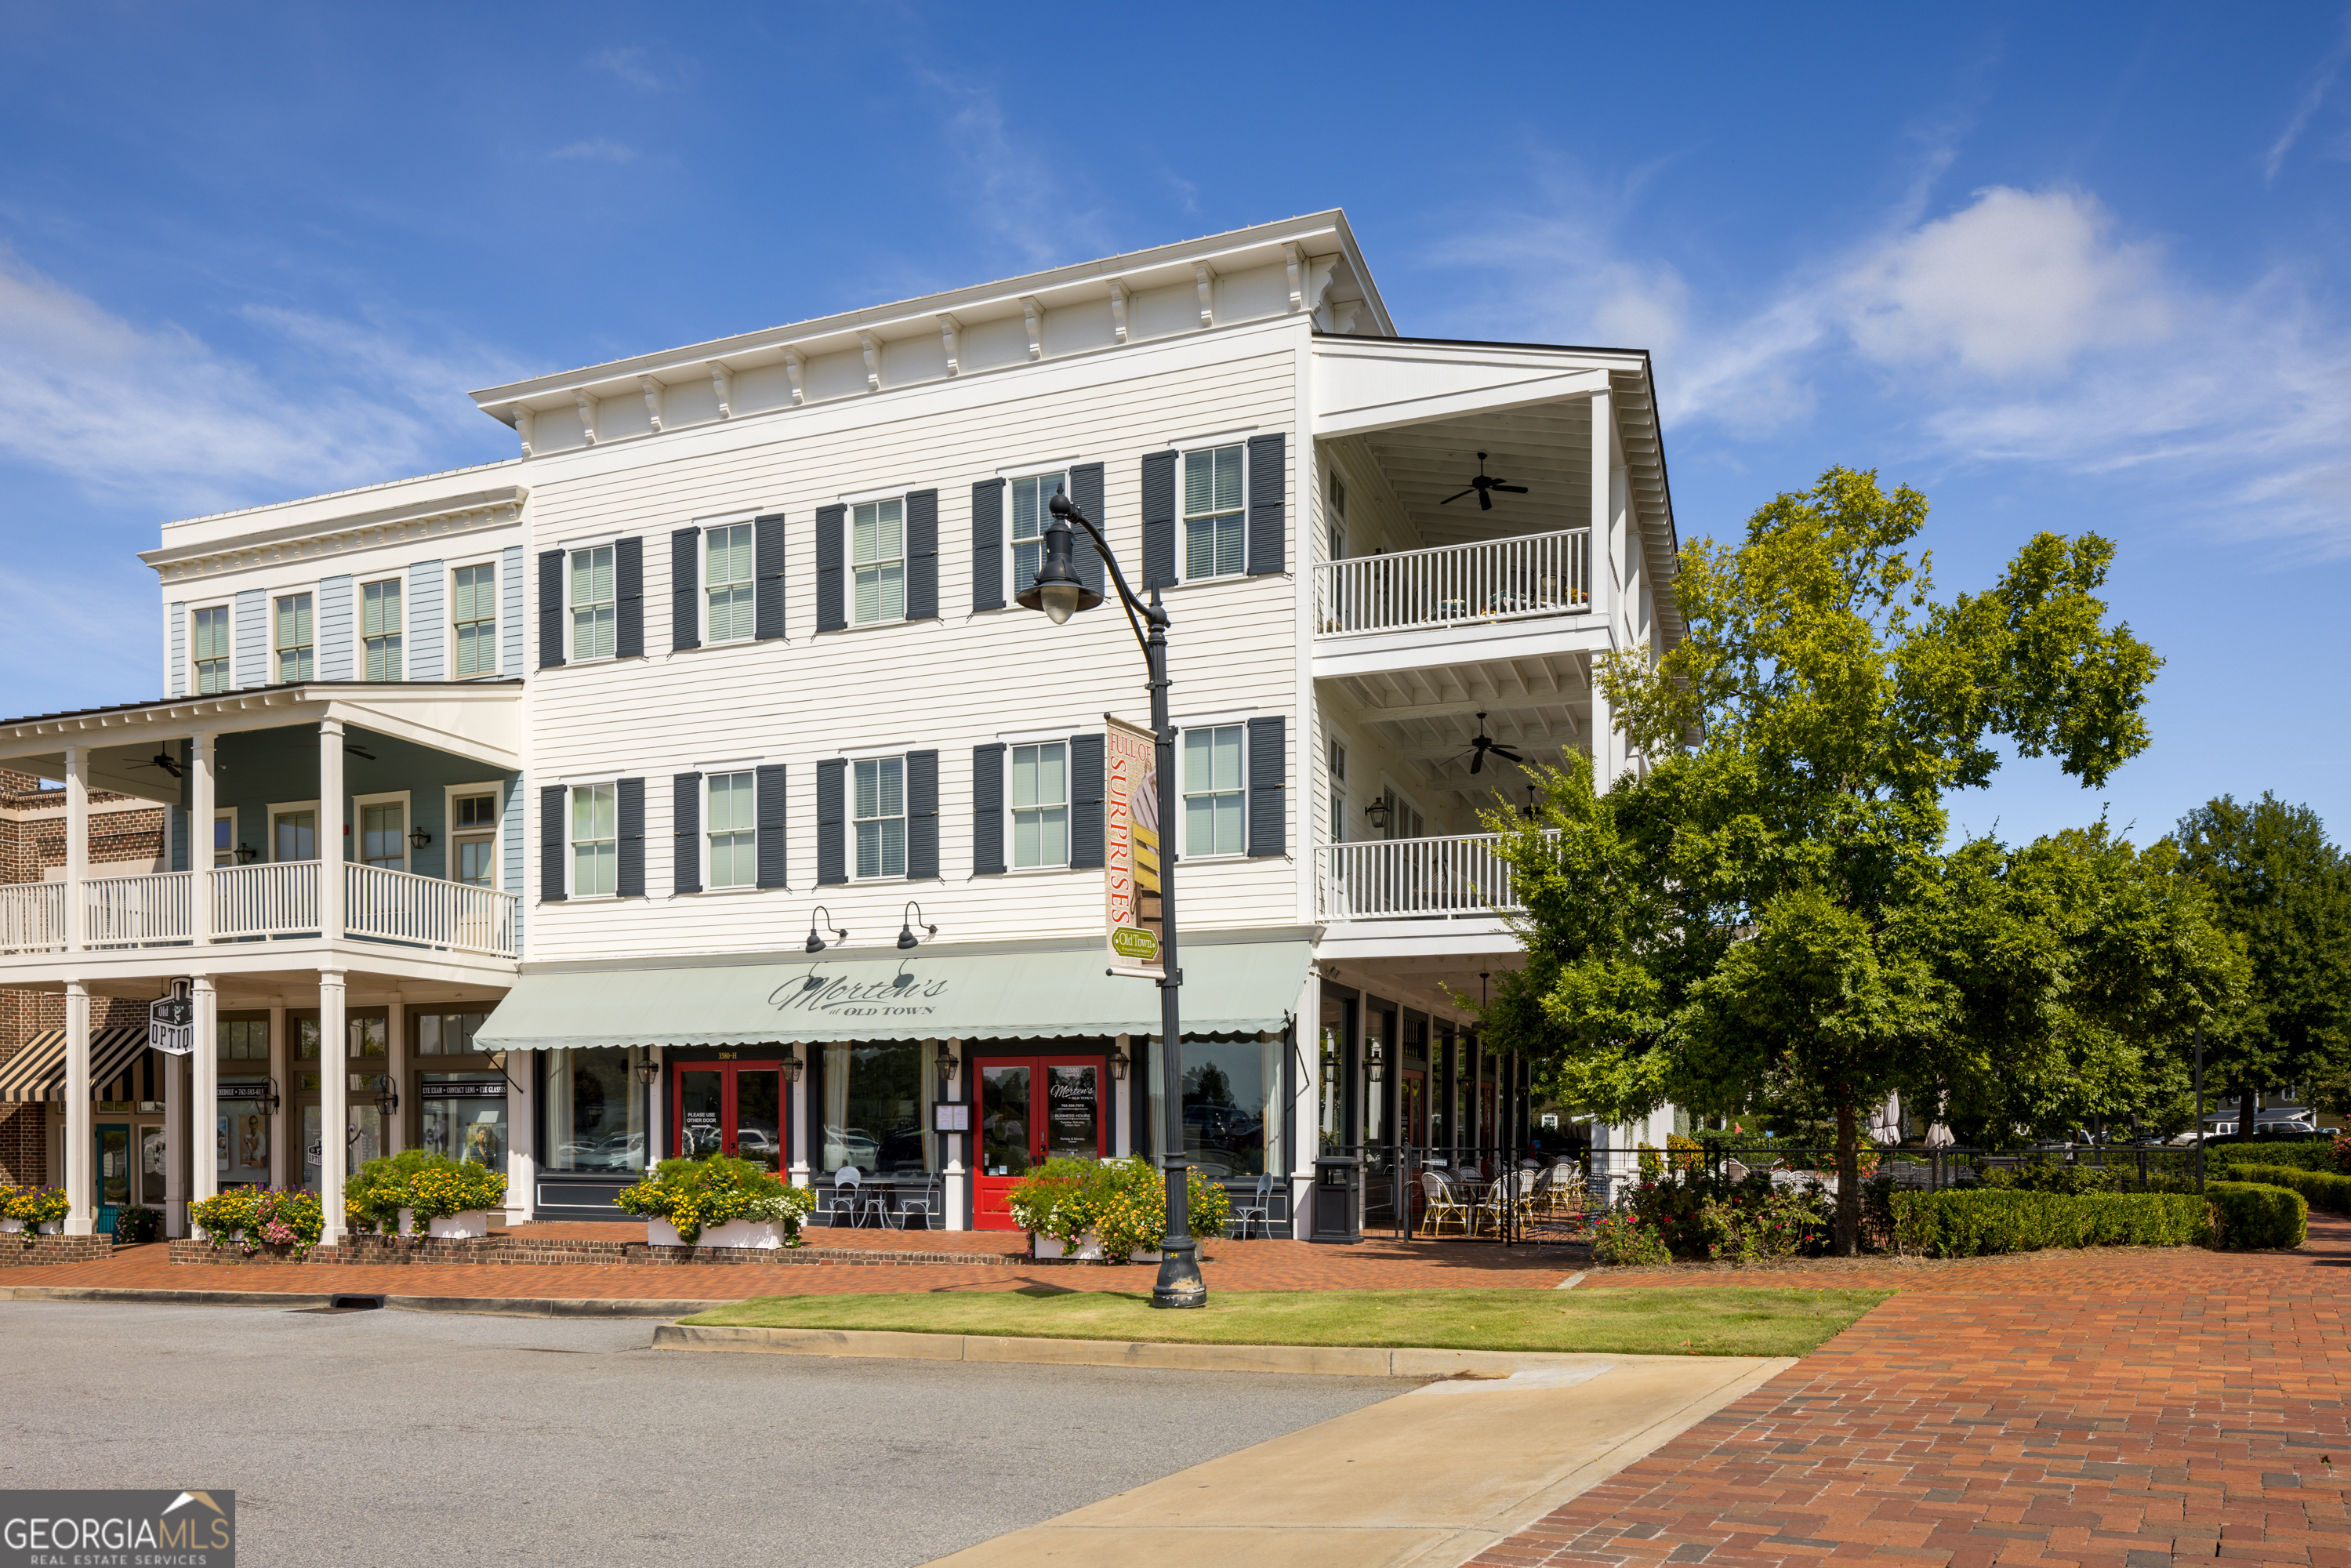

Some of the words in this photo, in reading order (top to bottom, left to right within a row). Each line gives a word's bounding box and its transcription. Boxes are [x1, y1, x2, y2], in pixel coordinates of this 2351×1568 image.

[1111, 733, 1136, 758] FULL
[1138, 743, 1151, 763] OF
[1110, 756, 1130, 924] SURPRISES
[1119, 933, 1133, 946] Old
[1133, 935, 1152, 948] Town
[768, 975, 948, 1011] Morten's
[158, 1006, 169, 1017] Old
[844, 1007, 878, 1016] OLD
[882, 1007, 936, 1015] TOWN
[1050, 1084, 1094, 1098] Morten's
